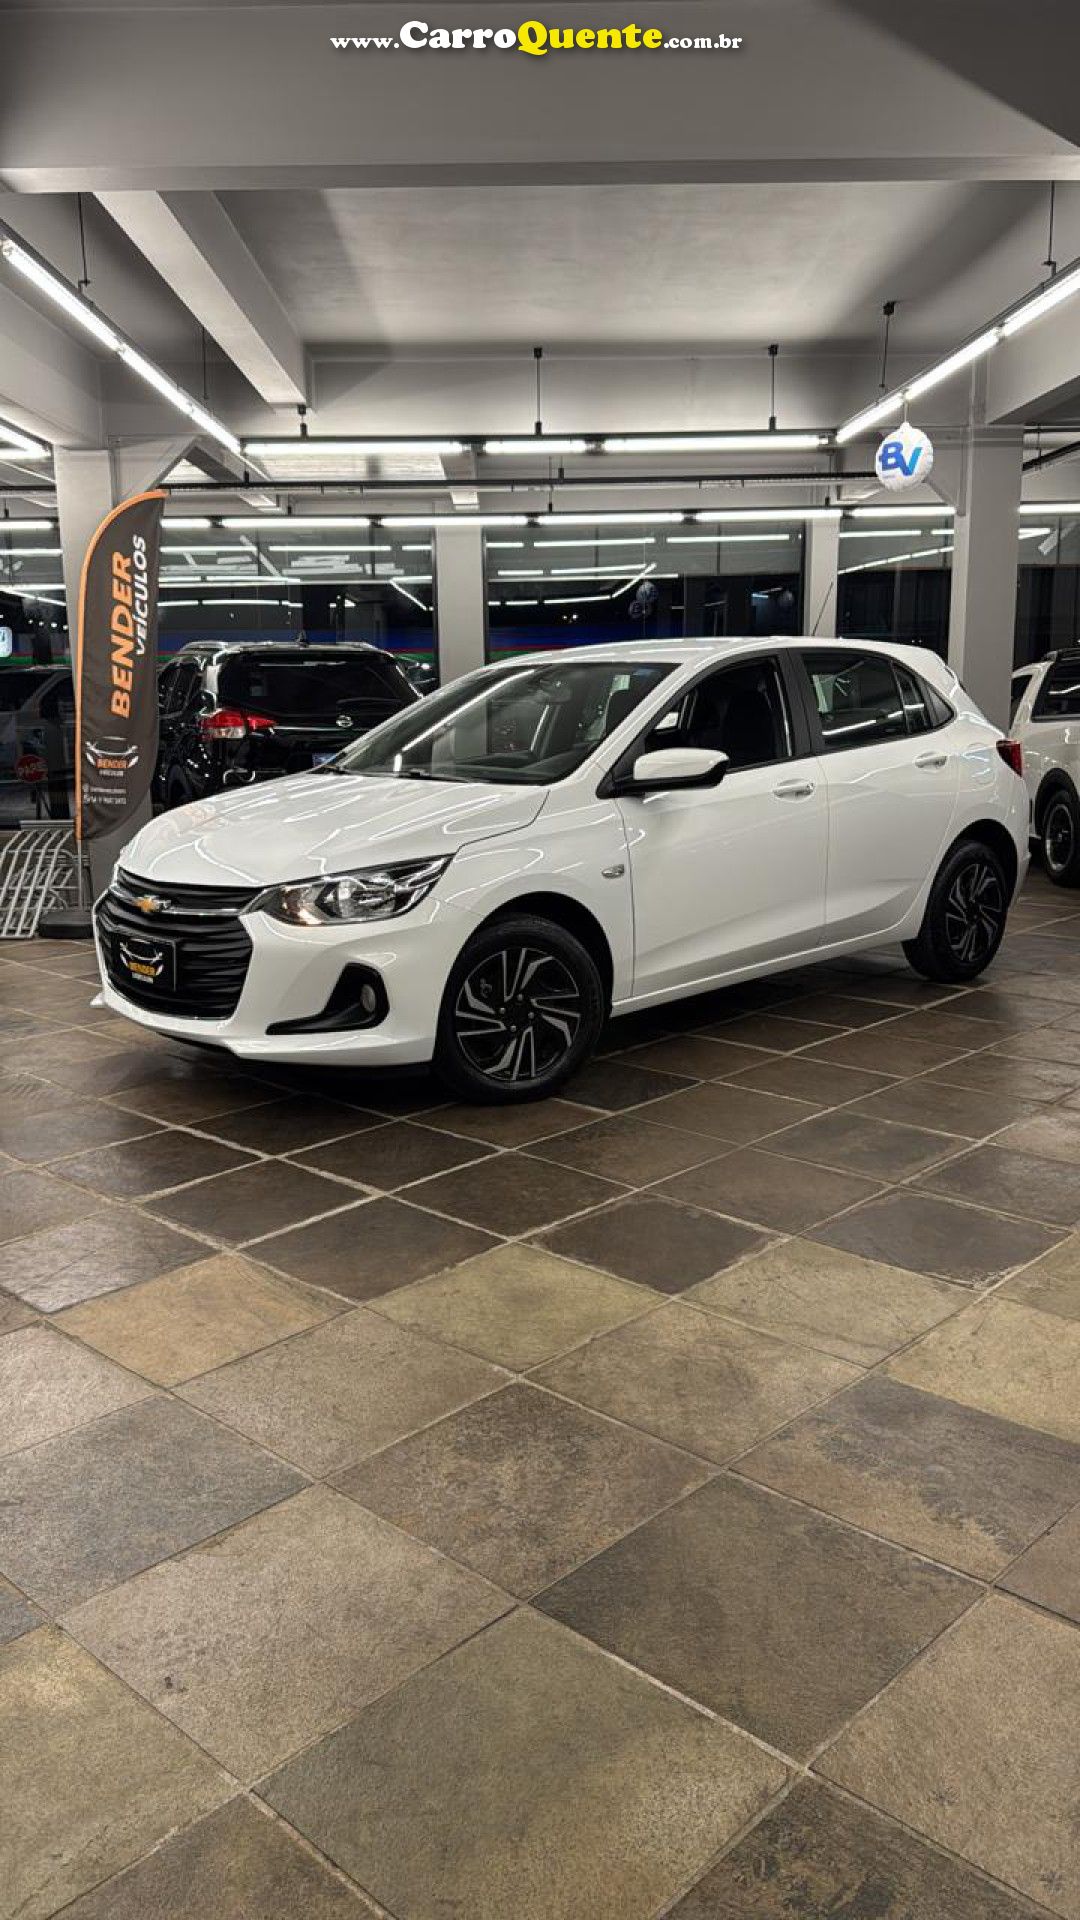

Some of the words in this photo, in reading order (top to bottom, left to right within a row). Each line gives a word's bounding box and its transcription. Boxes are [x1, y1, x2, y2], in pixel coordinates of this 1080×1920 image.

[879, 442, 923, 476] BV
[111, 551, 134, 719] BENDER
[132, 534, 148, 655] VEÍCULOS
